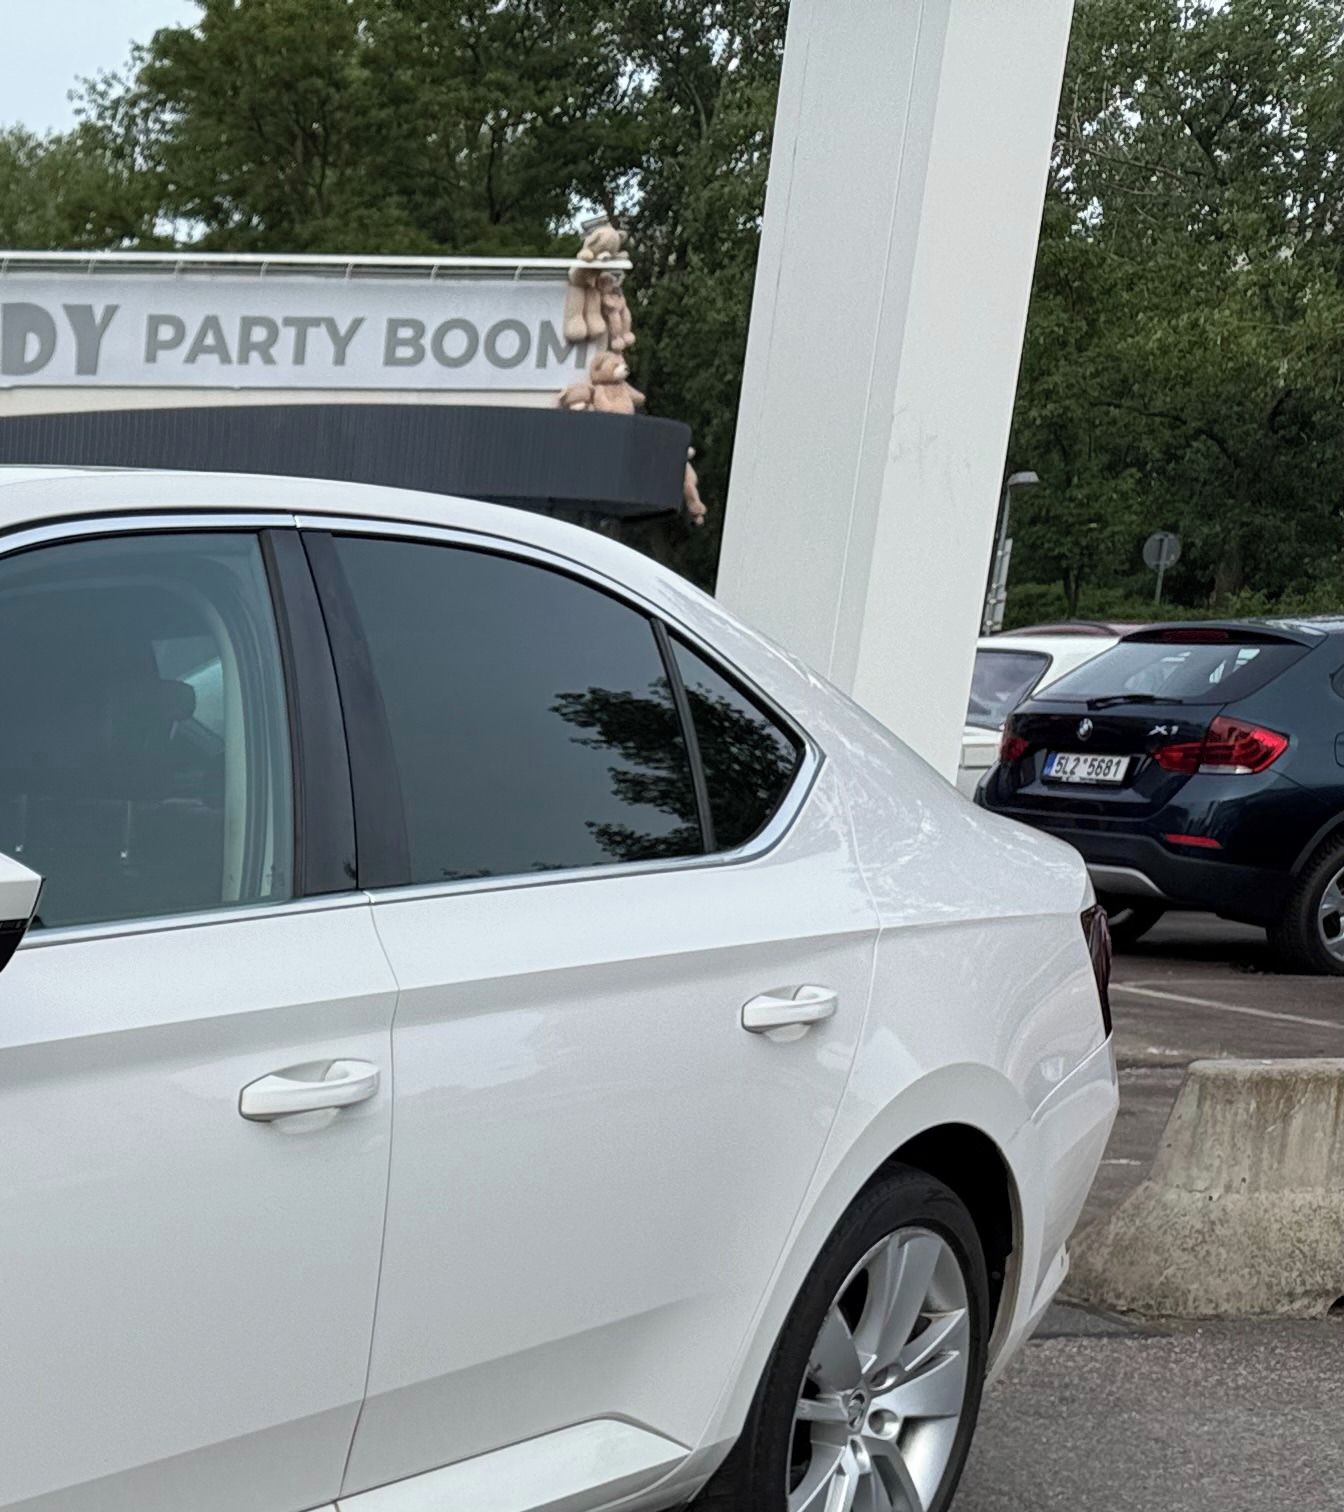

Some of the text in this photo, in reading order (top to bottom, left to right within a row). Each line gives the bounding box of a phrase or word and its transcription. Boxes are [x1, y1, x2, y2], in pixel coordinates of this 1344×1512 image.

[143, 313, 367, 367] PARTY
[382, 316, 589, 370] BOOM
[1147, 724, 1179, 736] X1
[1054, 755, 1122, 778] 5L2 5681
